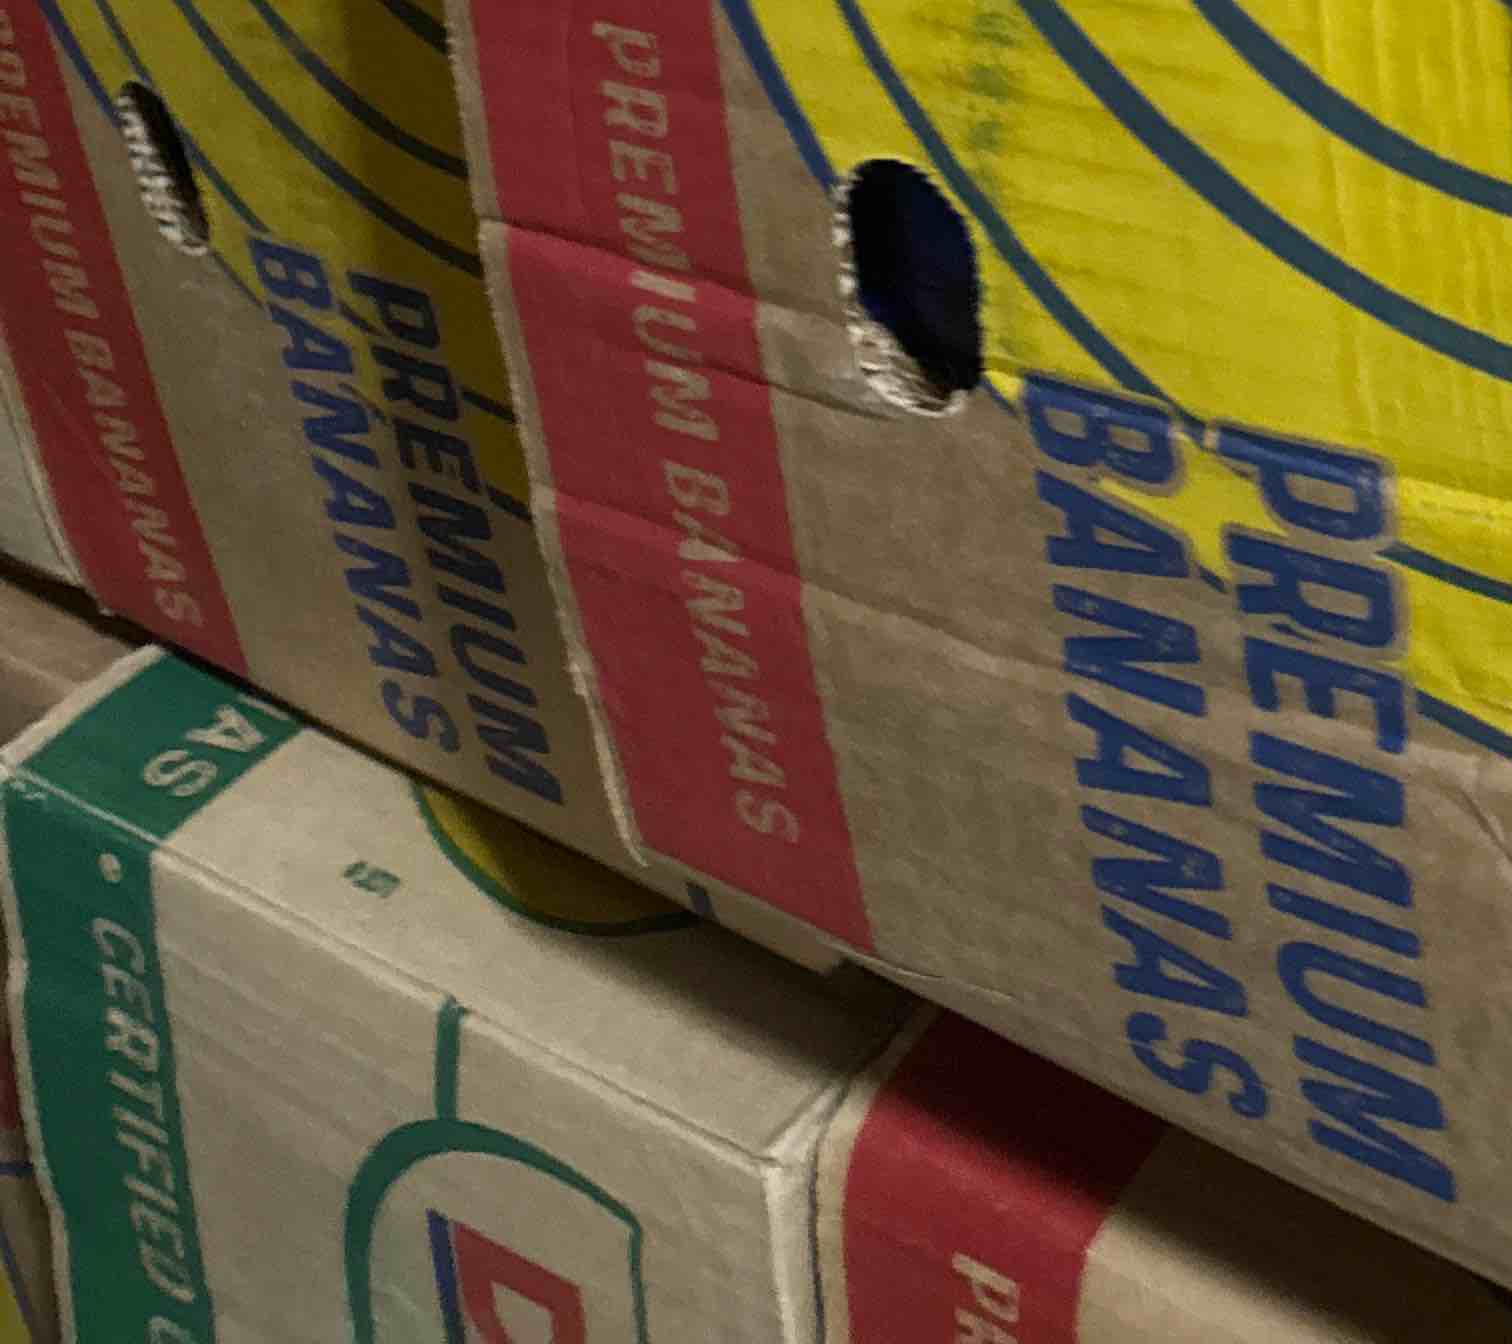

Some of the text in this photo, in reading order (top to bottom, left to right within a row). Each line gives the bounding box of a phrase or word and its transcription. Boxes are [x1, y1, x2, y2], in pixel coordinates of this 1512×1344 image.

[63, 331, 201, 632] BANANAS
[250, 230, 462, 754] BANANAS
[345, 270, 564, 807] PREMIUM
[593, 20, 722, 447] PREMIUM
[660, 459, 803, 847] BANANAS
[1023, 371, 1269, 1119] BANANAS
[1211, 419, 1457, 1204] PREMIUM
[93, 916, 197, 1306] CERTIFIED
